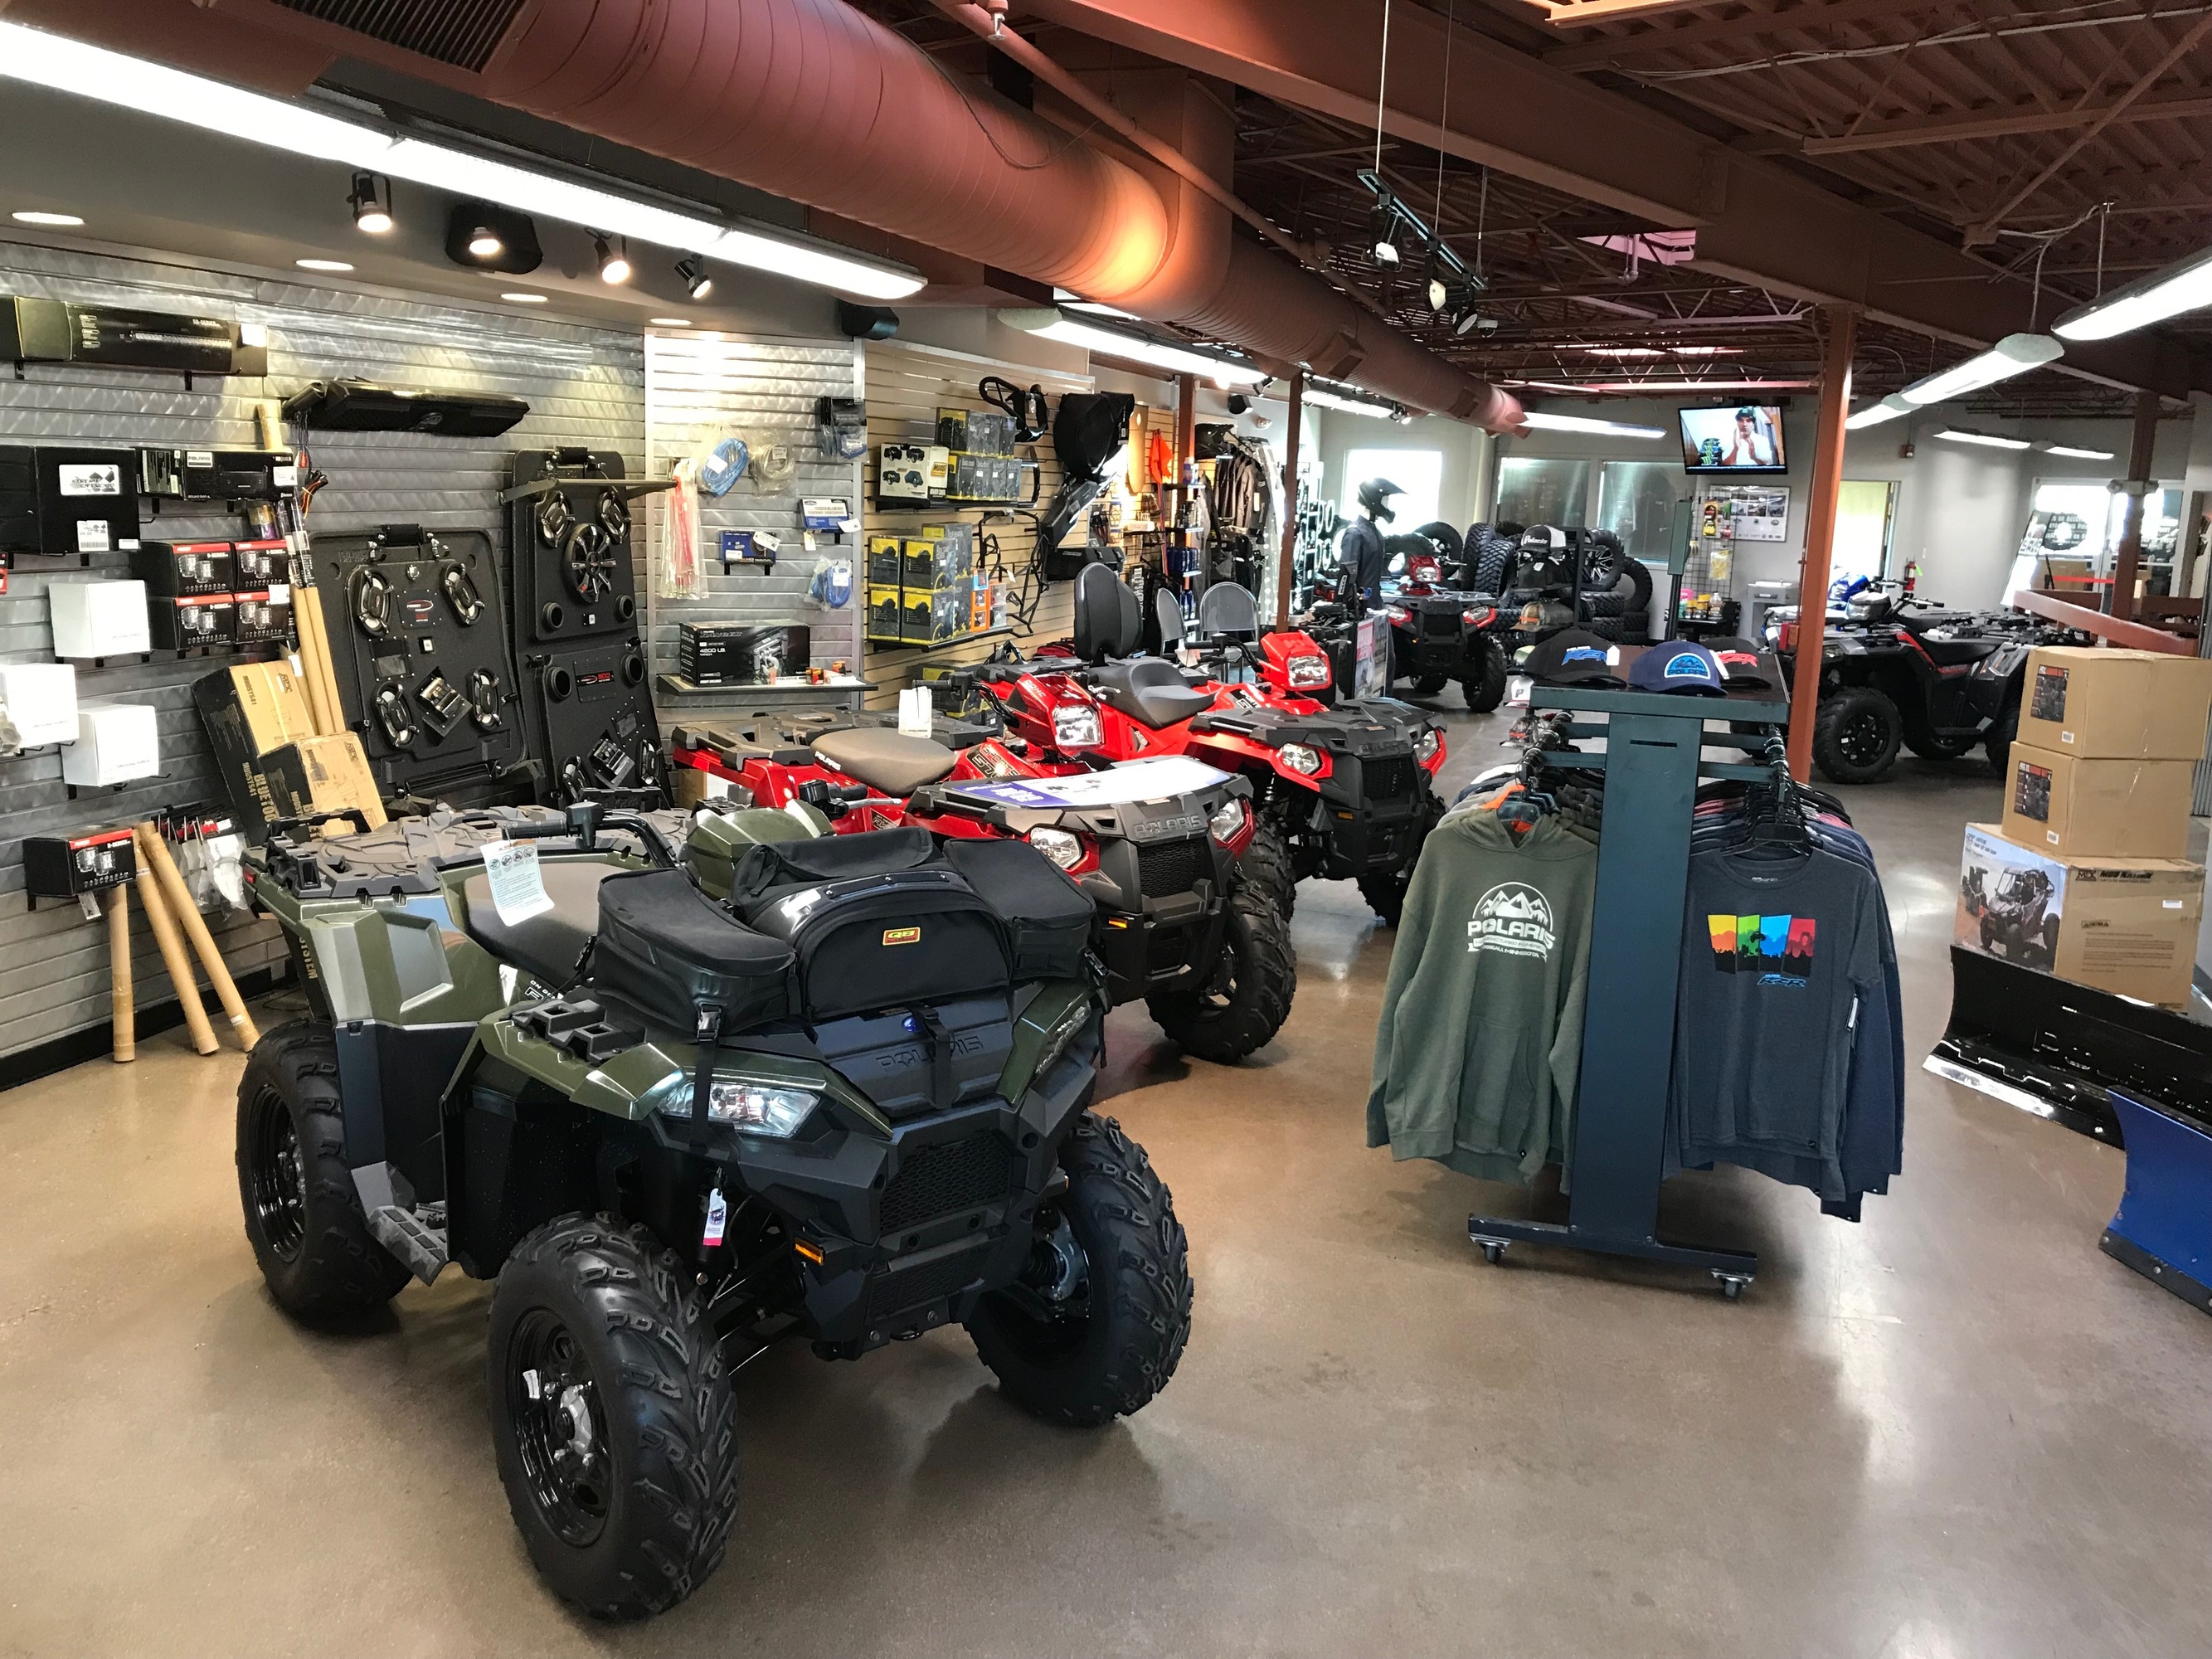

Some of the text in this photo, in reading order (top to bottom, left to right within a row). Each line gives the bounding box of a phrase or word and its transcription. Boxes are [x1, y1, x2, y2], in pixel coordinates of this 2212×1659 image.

[1523, 535, 1548, 545] Polaris
[1666, 669, 1709, 678] POLARIS
[242, 675, 258, 705] MUDSYS41
[814, 751, 841, 771] POLARIS
[241, 761, 257, 796] MUDSYS41
[253, 773, 277, 828] BLUETOO
[1133, 814, 1202, 835] POLARIS
[1467, 917, 1556, 950] POLARIS
[1504, 948, 1540, 958] MINNESOTA
[529, 980, 542, 990] ON
